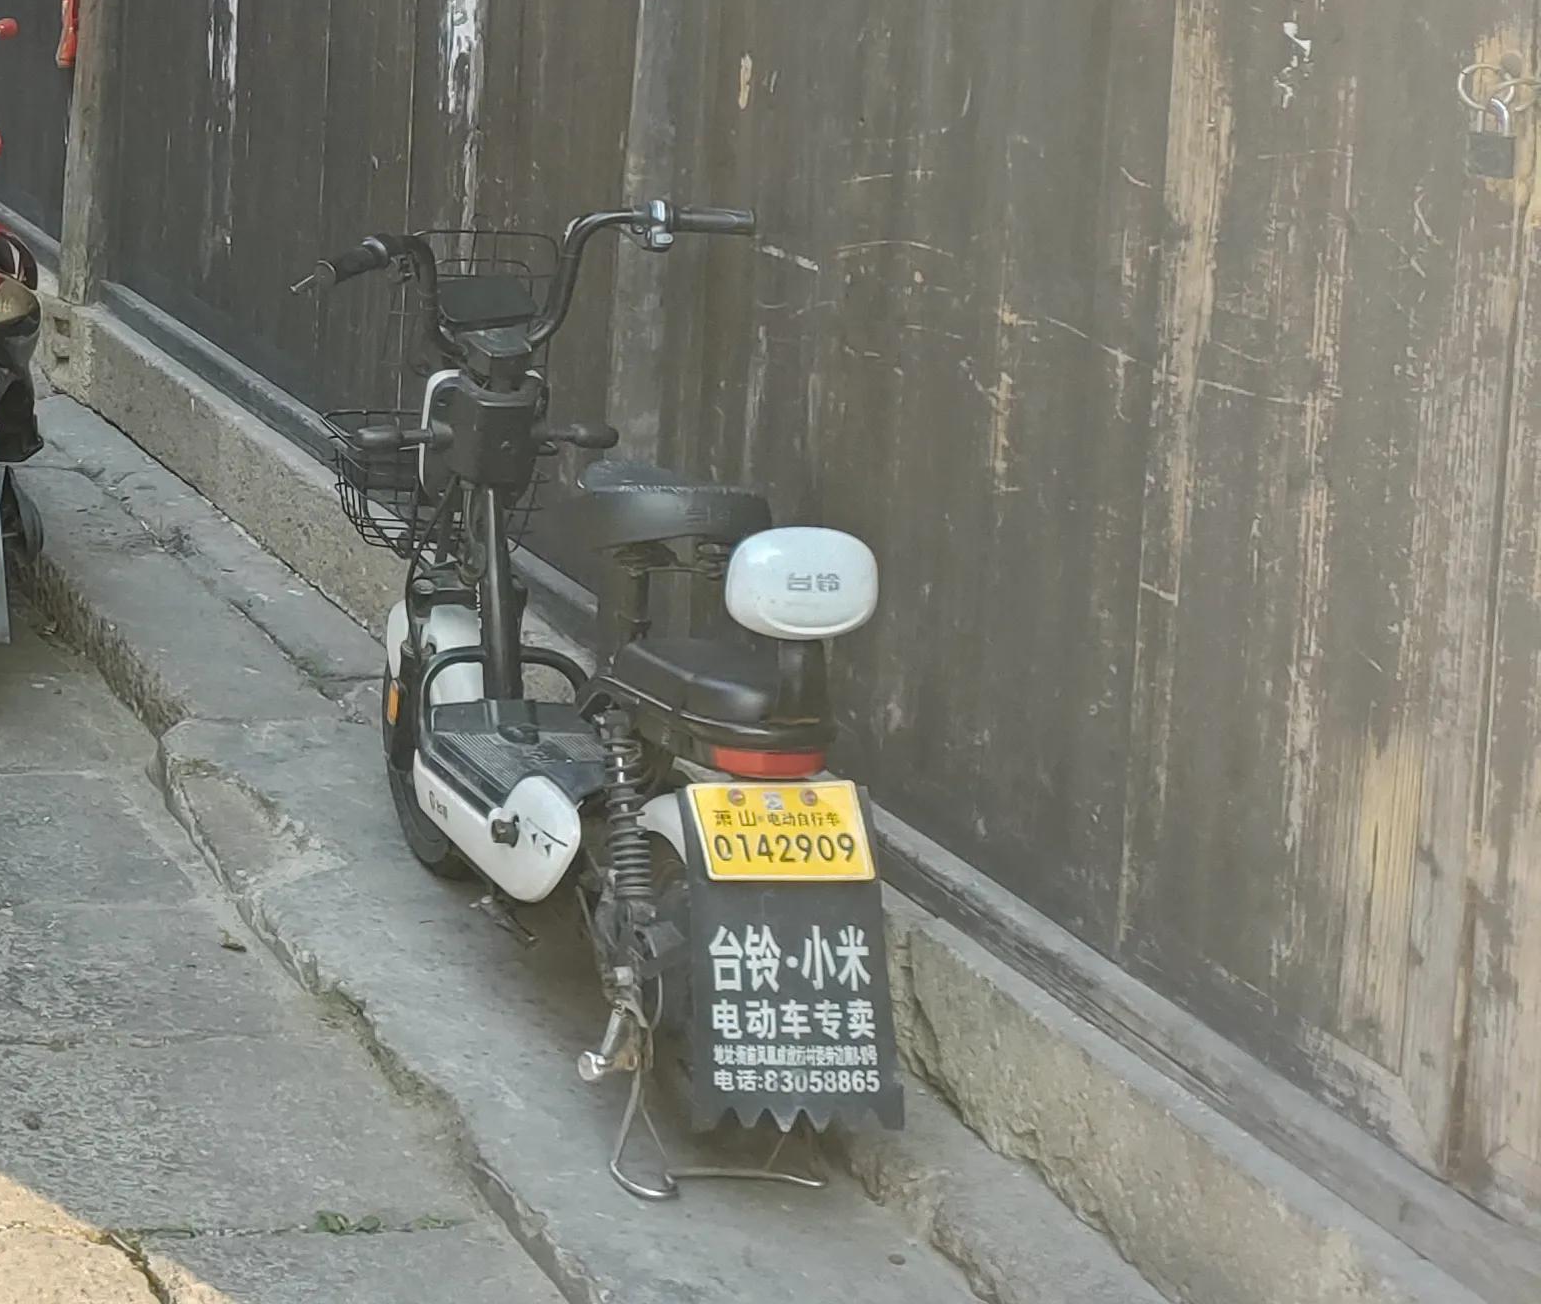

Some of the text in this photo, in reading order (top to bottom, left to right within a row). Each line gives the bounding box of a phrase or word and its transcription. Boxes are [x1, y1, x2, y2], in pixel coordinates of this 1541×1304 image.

[714, 833, 855, 863] 0142909
[712, 999, 877, 1041] 电动车专卖
